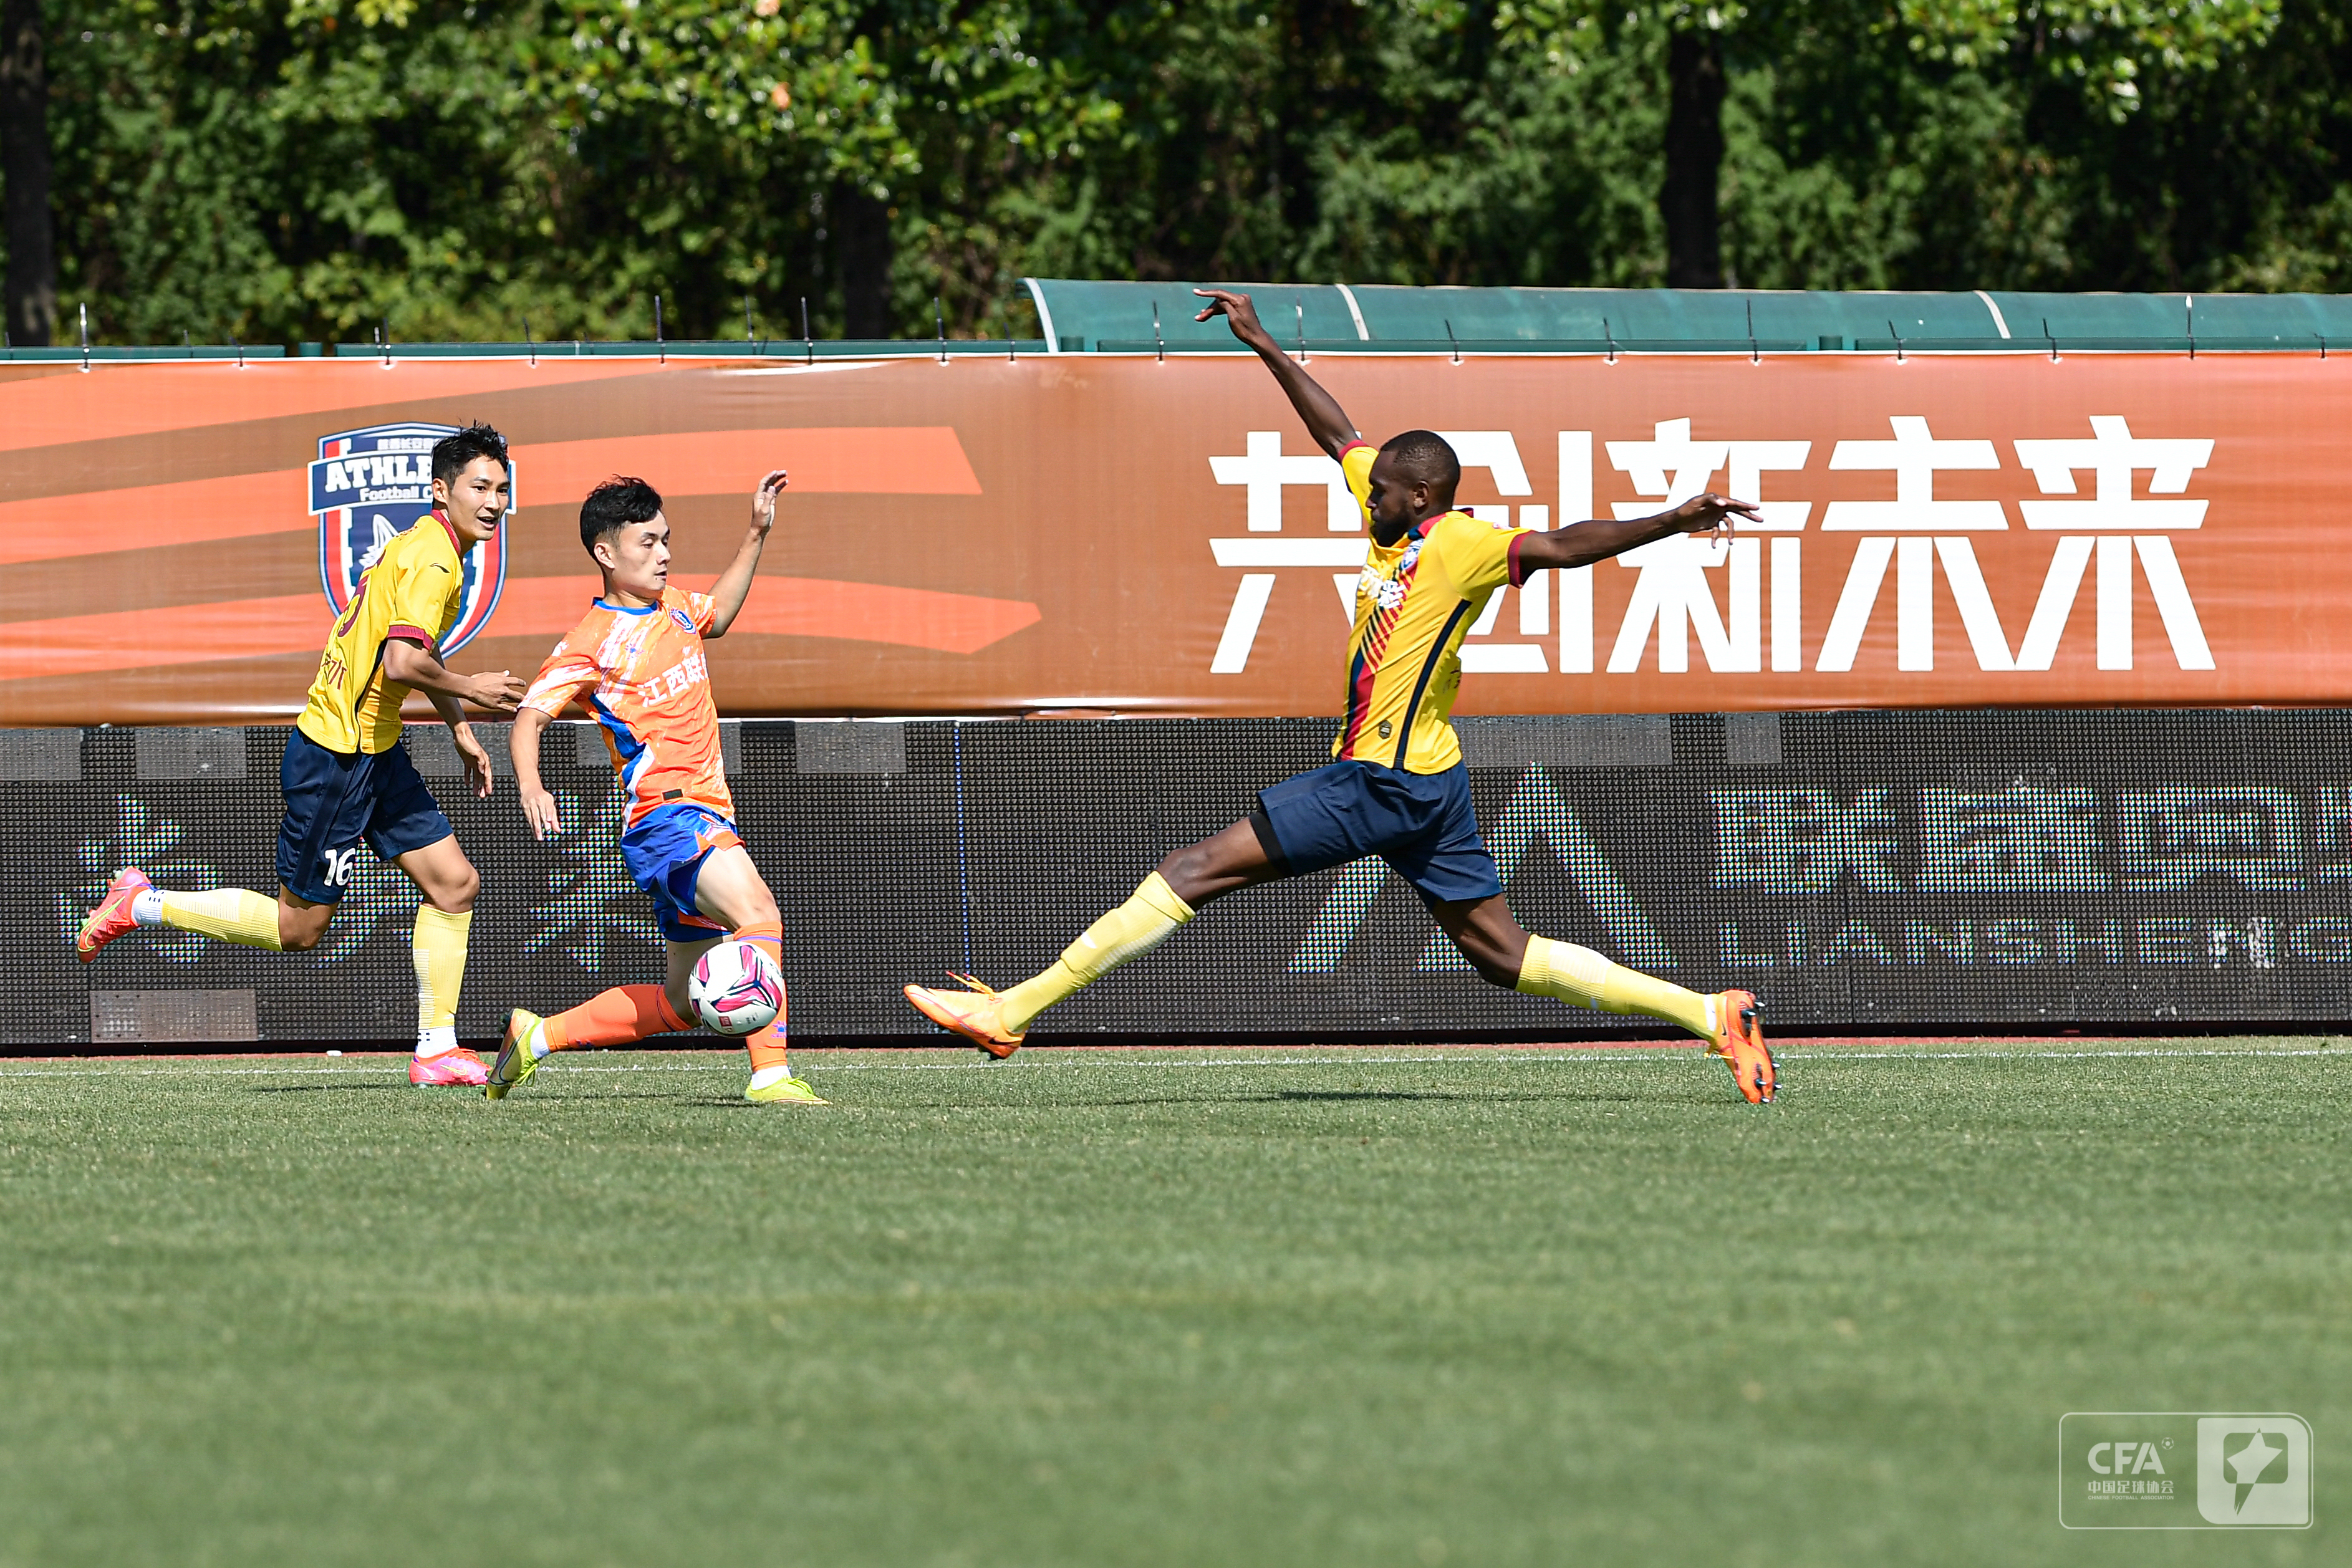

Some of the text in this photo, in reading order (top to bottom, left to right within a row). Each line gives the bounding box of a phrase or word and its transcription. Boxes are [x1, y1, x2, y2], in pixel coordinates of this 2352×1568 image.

[325, 456, 432, 493] ATHLE
[360, 486, 419, 501] Football
[1208, 415, 2216, 674] 共创新未来
[637, 653, 709, 708] 江西联
[324, 848, 356, 886] 16
[1718, 916, 2352, 968] LIANSHENG
